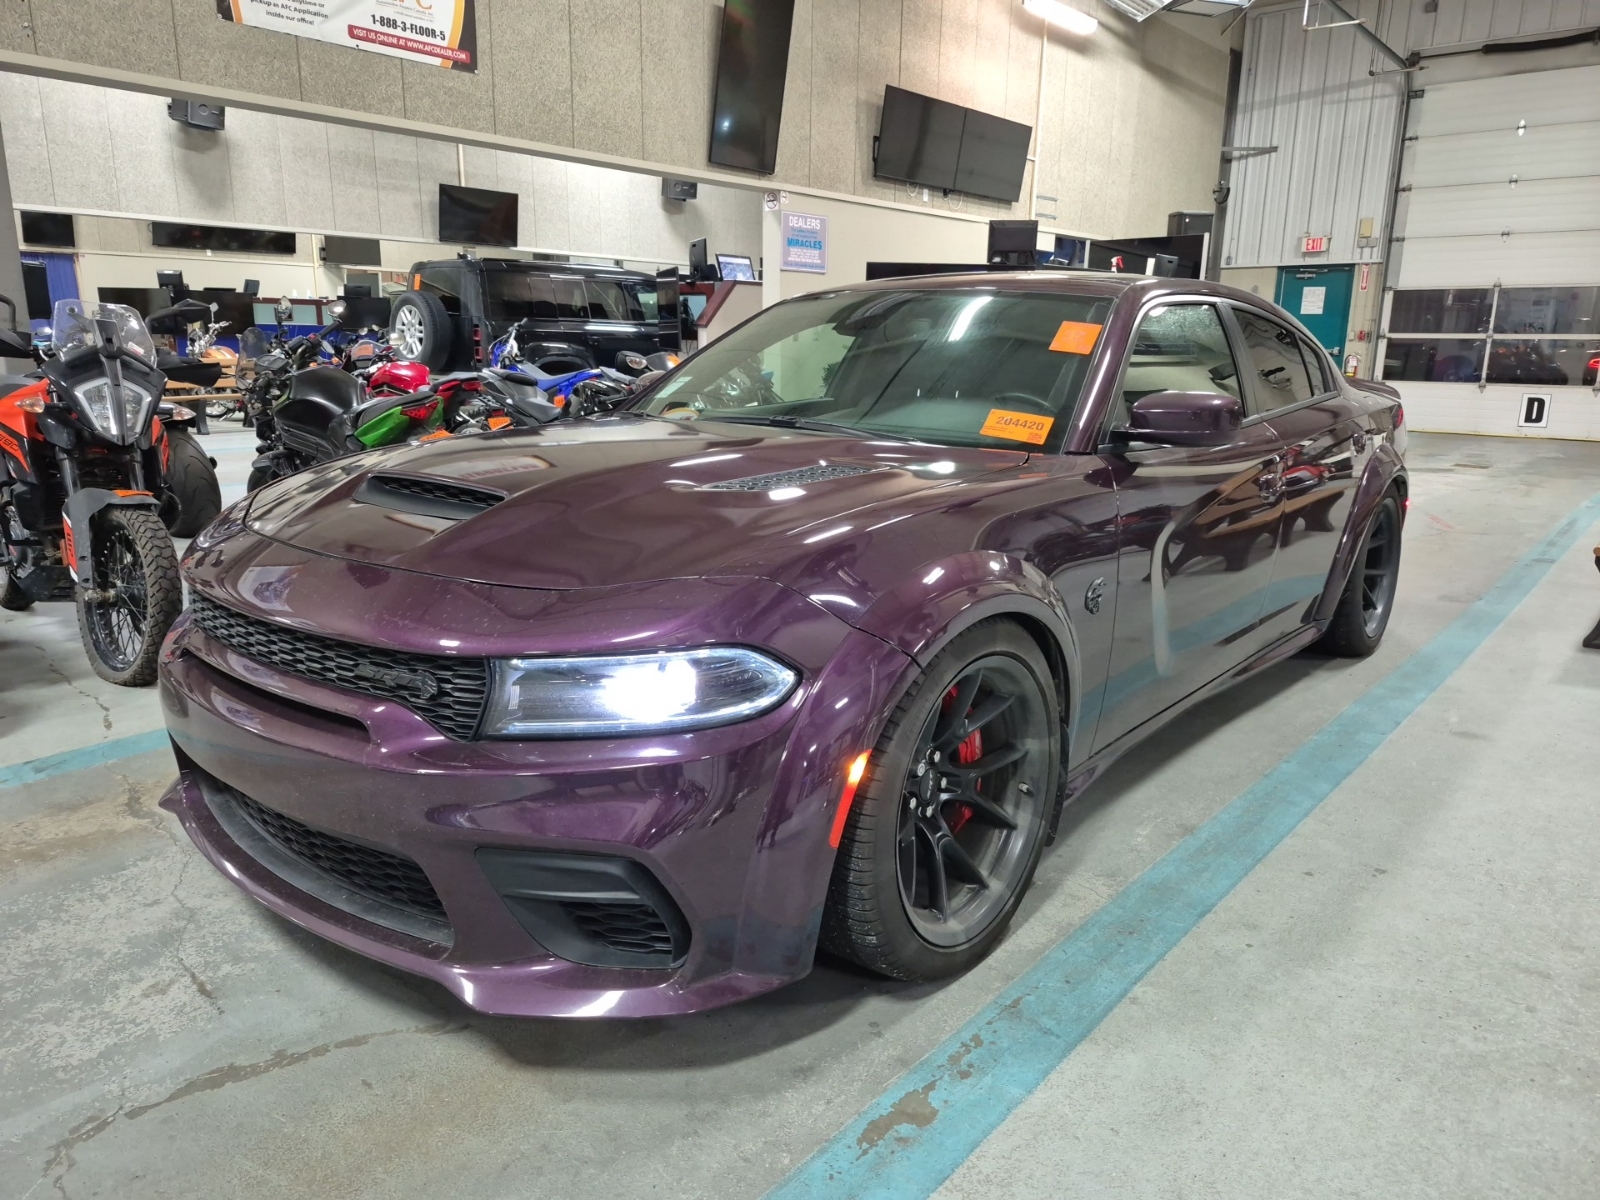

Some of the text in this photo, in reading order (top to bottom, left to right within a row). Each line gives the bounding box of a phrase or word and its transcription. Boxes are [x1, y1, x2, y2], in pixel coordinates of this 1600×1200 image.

[265, 10, 285, 19] inside
[294, 7, 329, 19] Application
[370, 14, 446, 41] 1-888-3-FLOOR-5
[352, 27, 367, 37] VISIT
[367, 31, 376, 40] US
[377, 33, 398, 44] ONLINE
[406, 40, 466, 60] WWW.AFCDEALER.COM
[789, 216, 820, 229] DEALERS
[787, 237, 822, 250] MIRACLES
[1306, 237, 1323, 251] EXIT
[1523, 397, 1546, 423] D
[995, 416, 1045, 431] 204420
